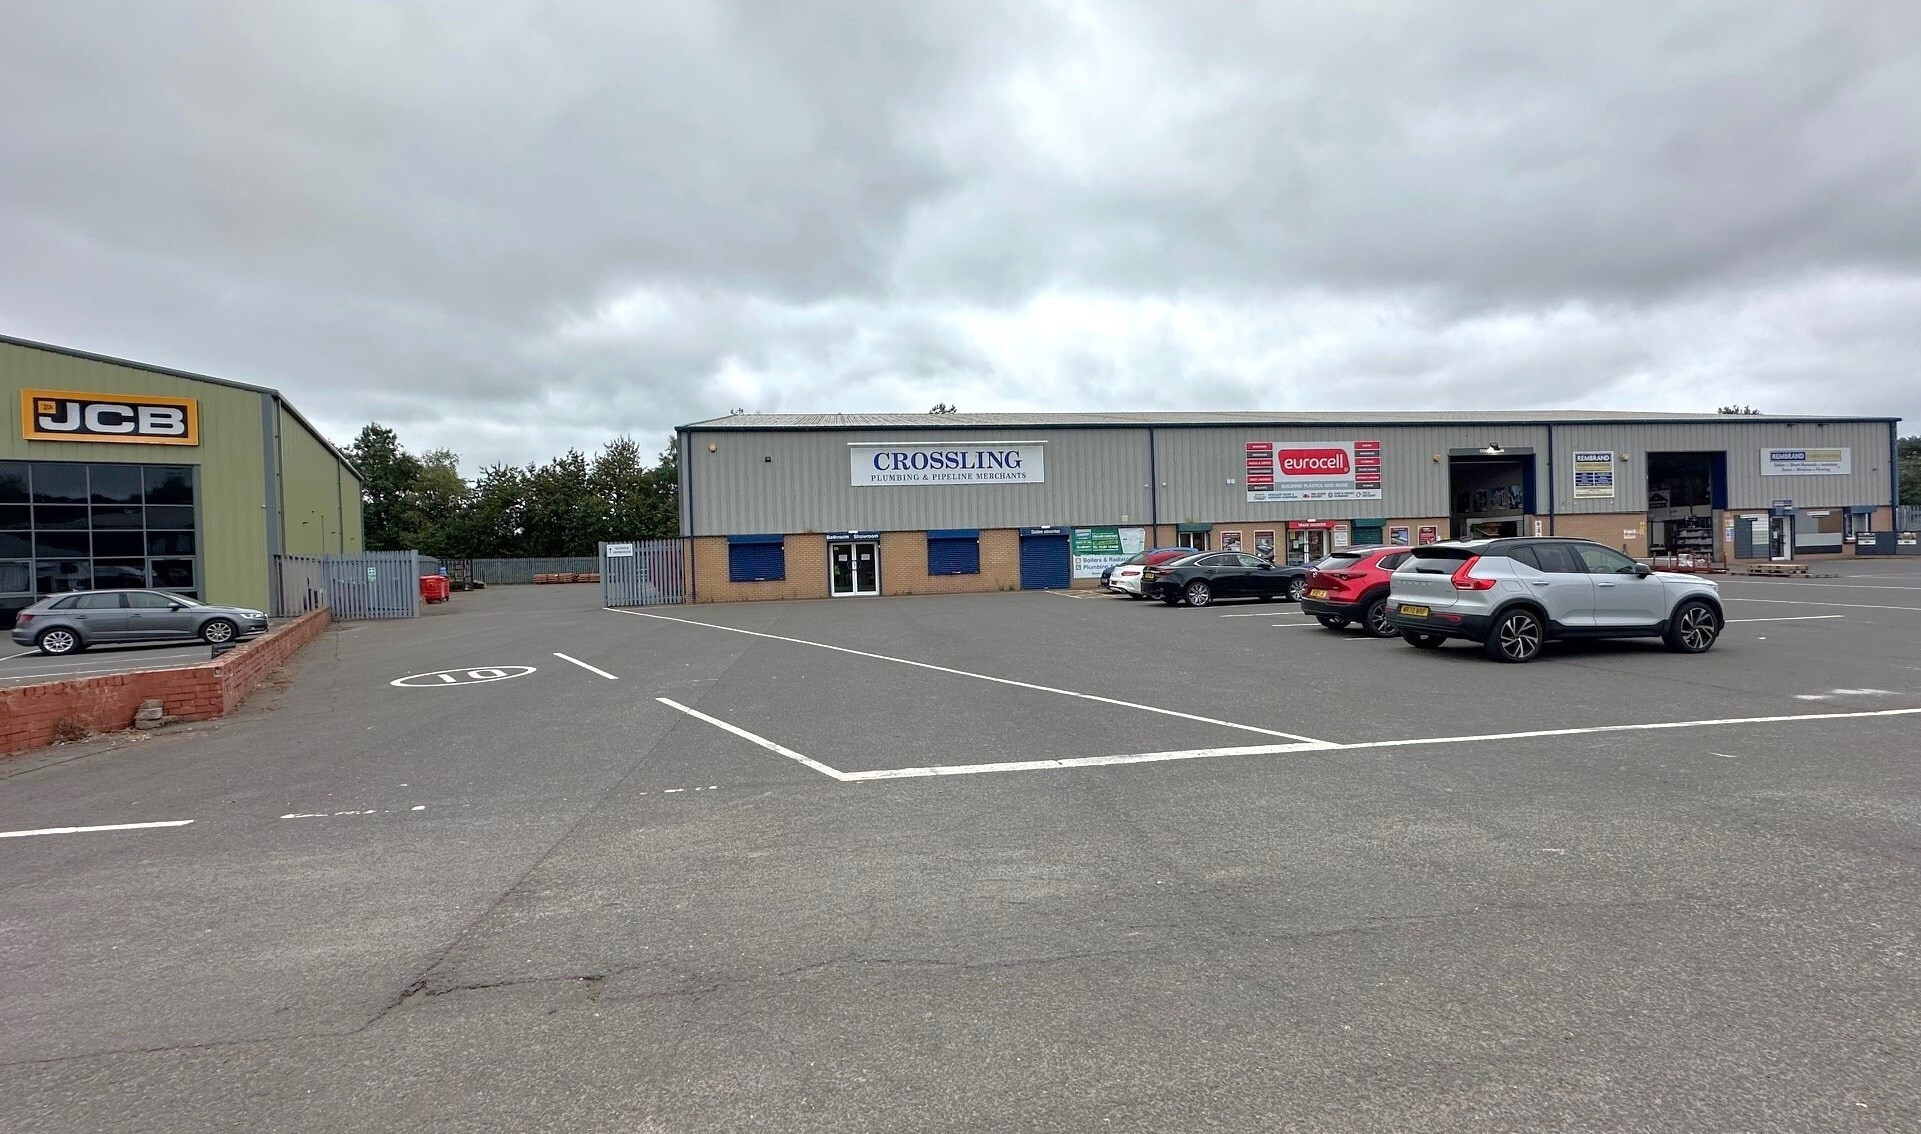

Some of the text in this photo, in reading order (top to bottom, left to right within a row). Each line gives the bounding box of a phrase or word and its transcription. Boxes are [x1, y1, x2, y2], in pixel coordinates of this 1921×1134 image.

[38, 402, 185, 435] JCB
[873, 450, 1022, 471] CROSSLING
[1283, 453, 1344, 470] eurocell
[870, 474, 920, 482] PLUMBING
[932, 473, 973, 481] PIPELINE
[975, 472, 1027, 480] MERCHANTS
[437, 669, 508, 683] 10
